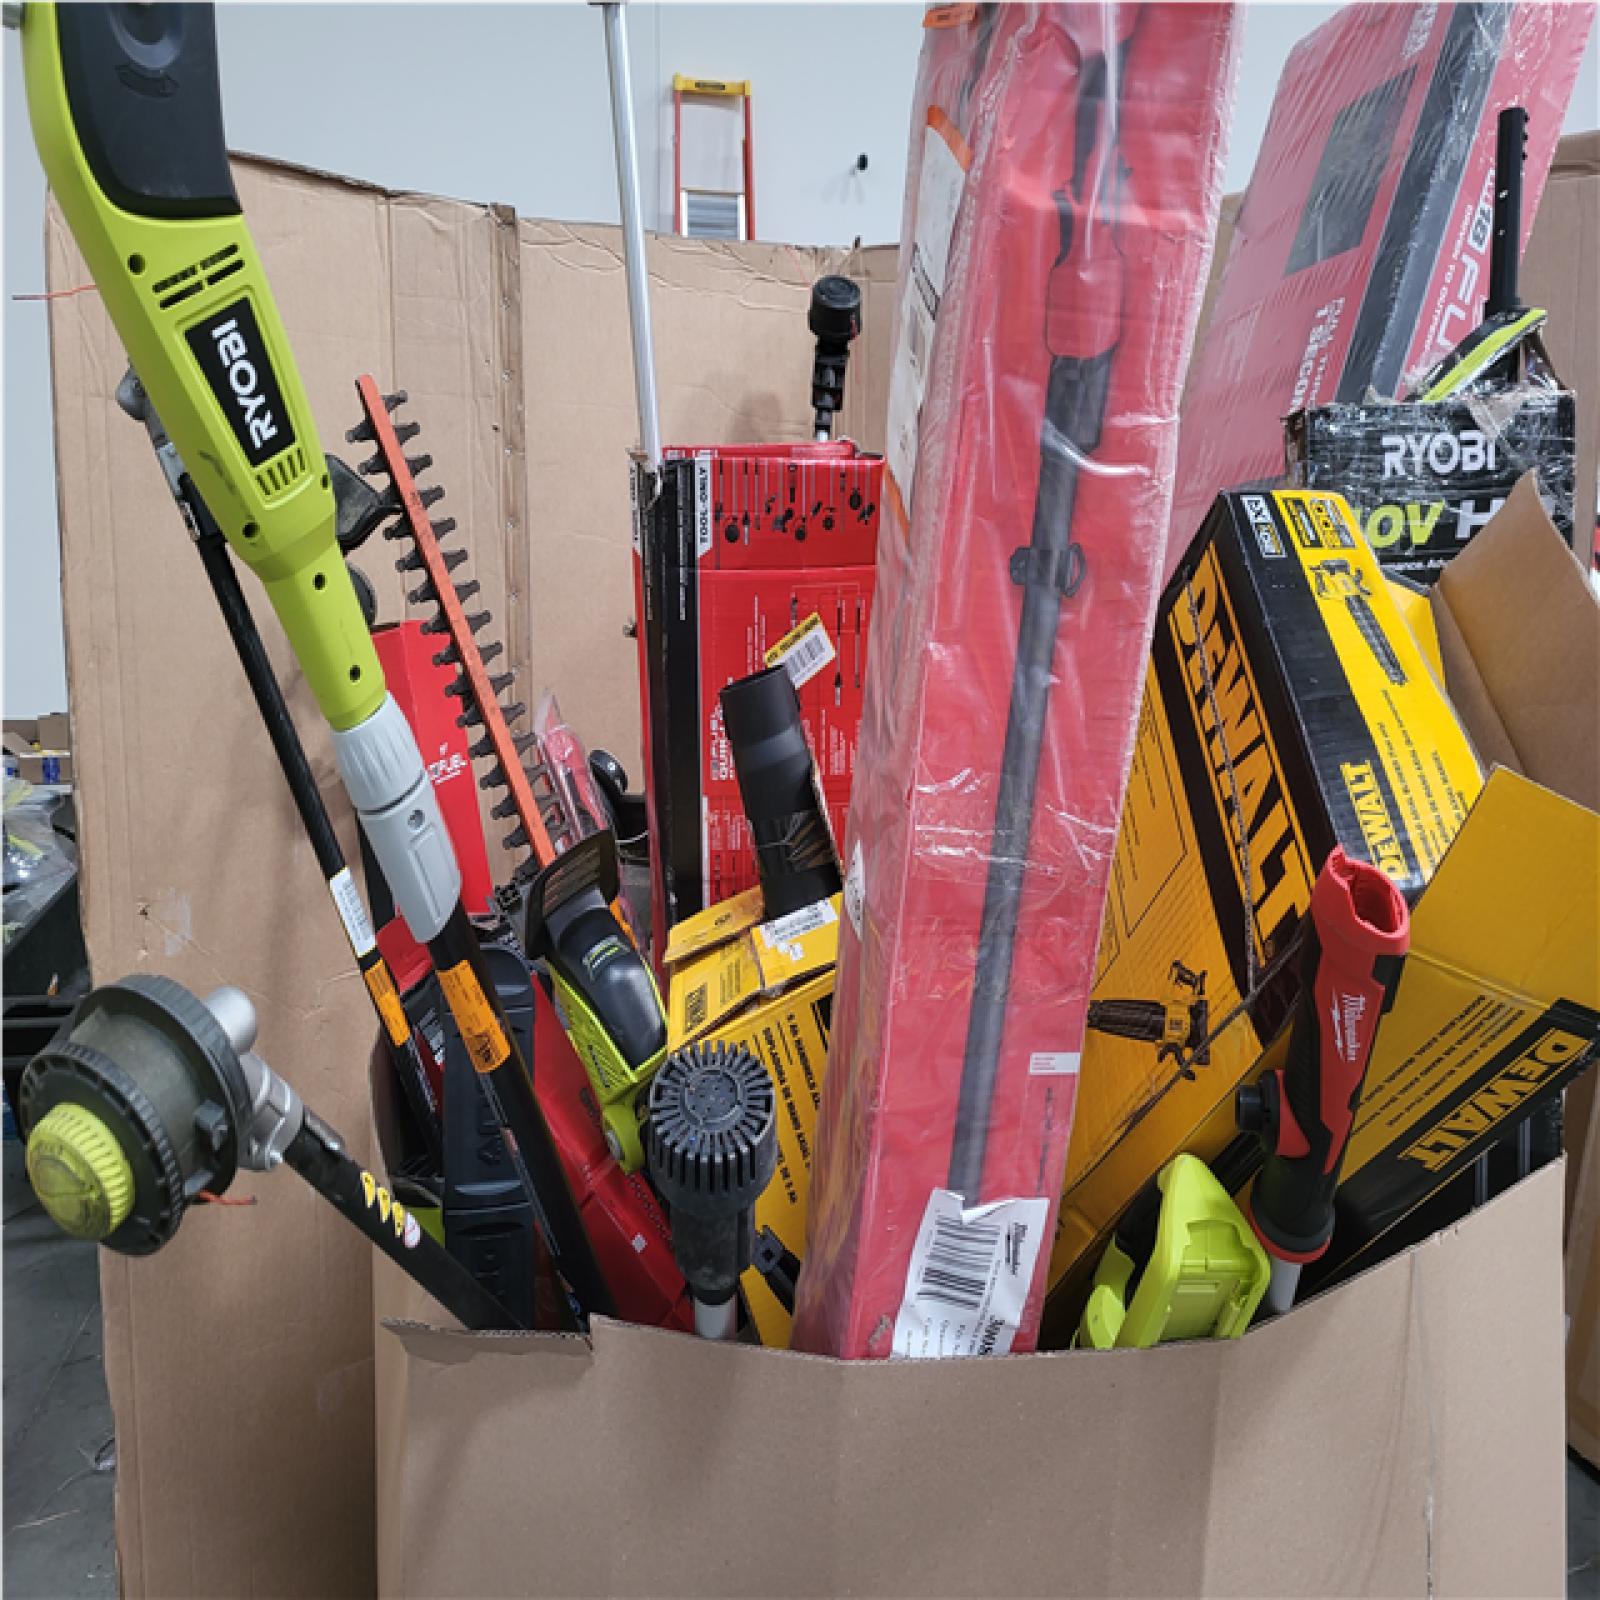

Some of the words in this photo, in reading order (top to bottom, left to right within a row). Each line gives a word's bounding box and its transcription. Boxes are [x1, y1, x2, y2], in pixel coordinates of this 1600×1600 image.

[211, 318, 279, 449] RYOBI
[699, 466, 708, 544] TOOL-ONLY
[1381, 431, 1497, 478] RYOBI
[1351, 498, 1446, 549] 0V
[1170, 551, 1312, 944] DEWALT
[1339, 759, 1409, 880] DEWALT
[1406, 1028, 1591, 1172] DEWALT
